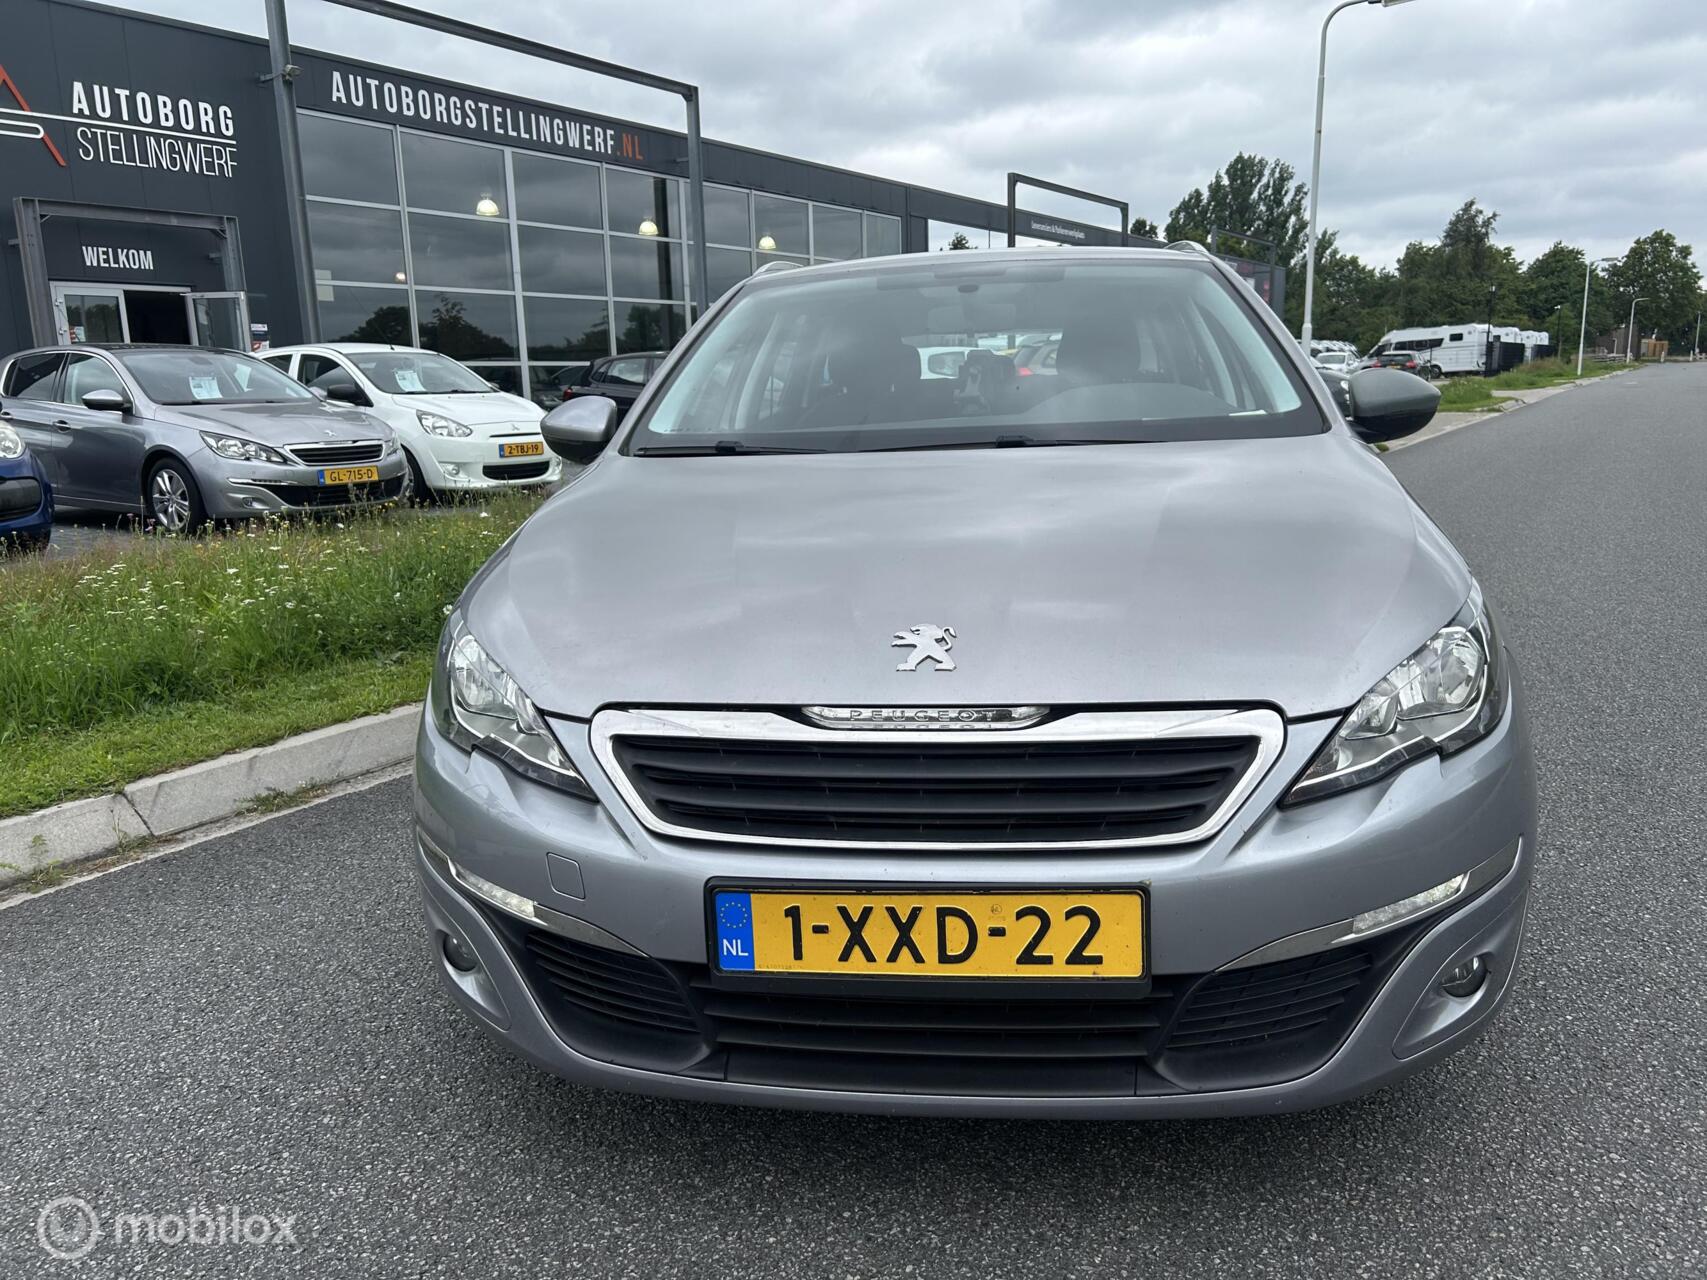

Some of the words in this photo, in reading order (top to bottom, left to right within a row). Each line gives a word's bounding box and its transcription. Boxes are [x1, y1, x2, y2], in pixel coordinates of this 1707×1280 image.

[72, 81, 235, 136] AUTOBORG
[331, 70, 645, 161] AUTOBORGSTELLINGWERF.NL
[76, 126, 238, 178] STELLINGWERF
[82, 245, 154, 270] WELKOM
[330, 468, 373, 482] GL-715-D
[850, 709, 997, 722] PEUGEOT
[723, 939, 749, 957] NL
[783, 904, 1104, 966] 1-XXD-22
